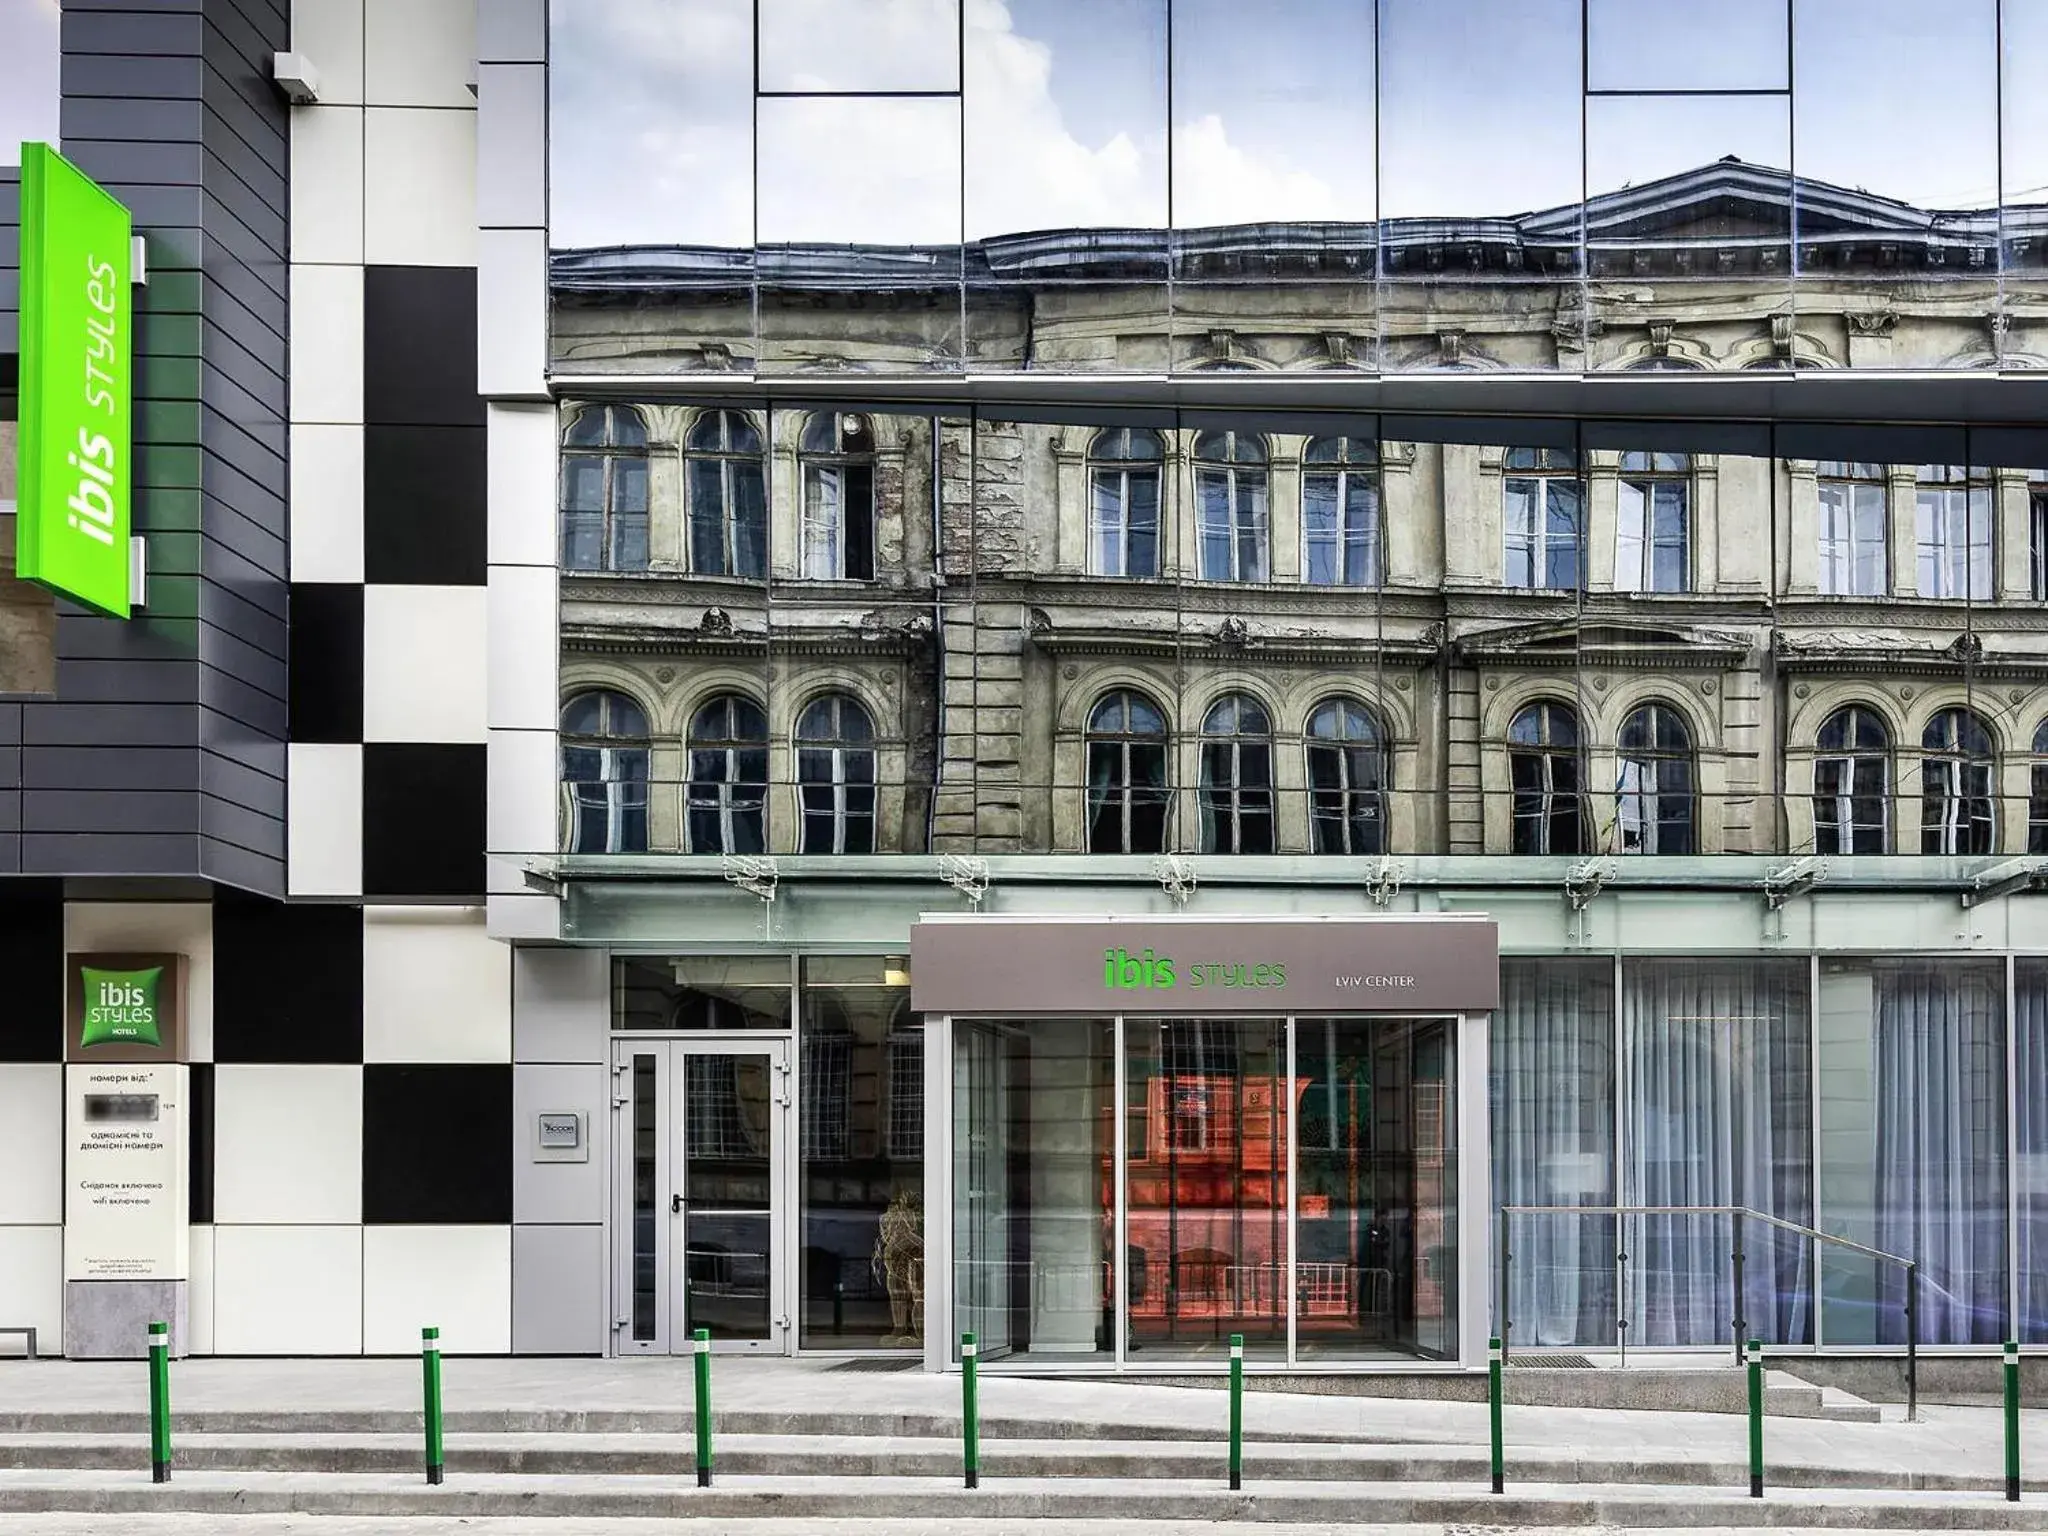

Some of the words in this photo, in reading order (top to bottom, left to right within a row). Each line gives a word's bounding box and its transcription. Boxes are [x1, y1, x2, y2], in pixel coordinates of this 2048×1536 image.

[68, 426, 114, 546] ibis
[1104, 948, 1176, 988] ibis
[1336, 976, 1361, 987] LVIV
[1365, 975, 1414, 987] CENTER
[100, 982, 144, 1006] ibis
[90, 1075, 128, 1084] номери
[125, 1142, 163, 1151] номери
